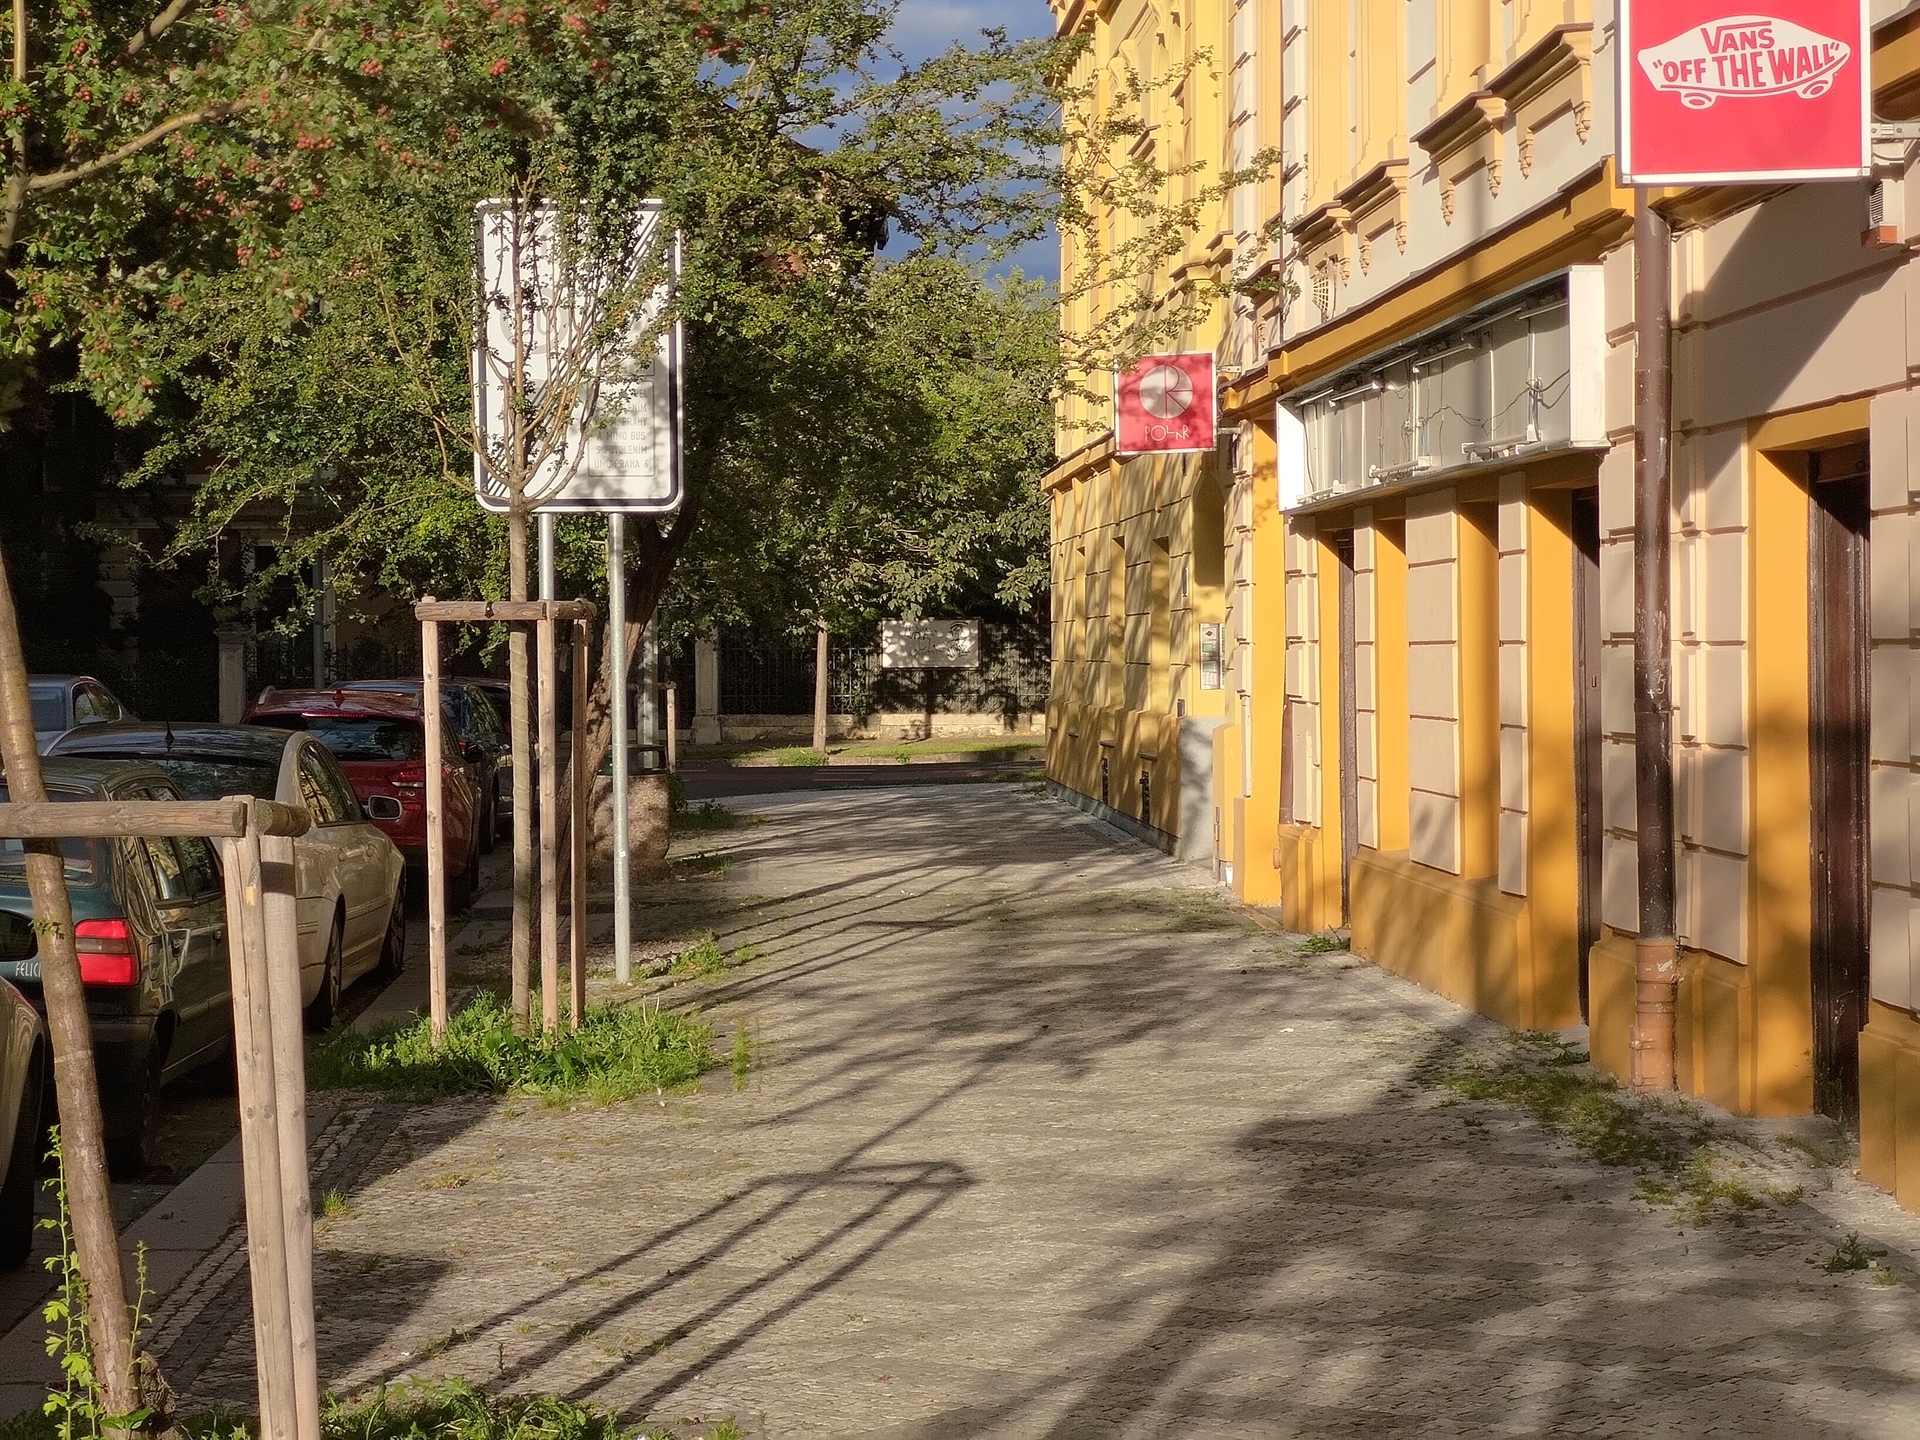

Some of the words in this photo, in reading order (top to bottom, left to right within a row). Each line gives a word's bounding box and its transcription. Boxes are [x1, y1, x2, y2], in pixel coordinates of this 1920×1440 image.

[1700, 20, 1775, 54] VANS
[1711, 51, 1767, 88] THE
[630, 431, 646, 441] BUS
[595, 445, 601, 455] S
[604, 443, 648, 455] POVOLENÍM
[614, 459, 640, 469] PRAHA
[643, 459, 649, 469] 6
